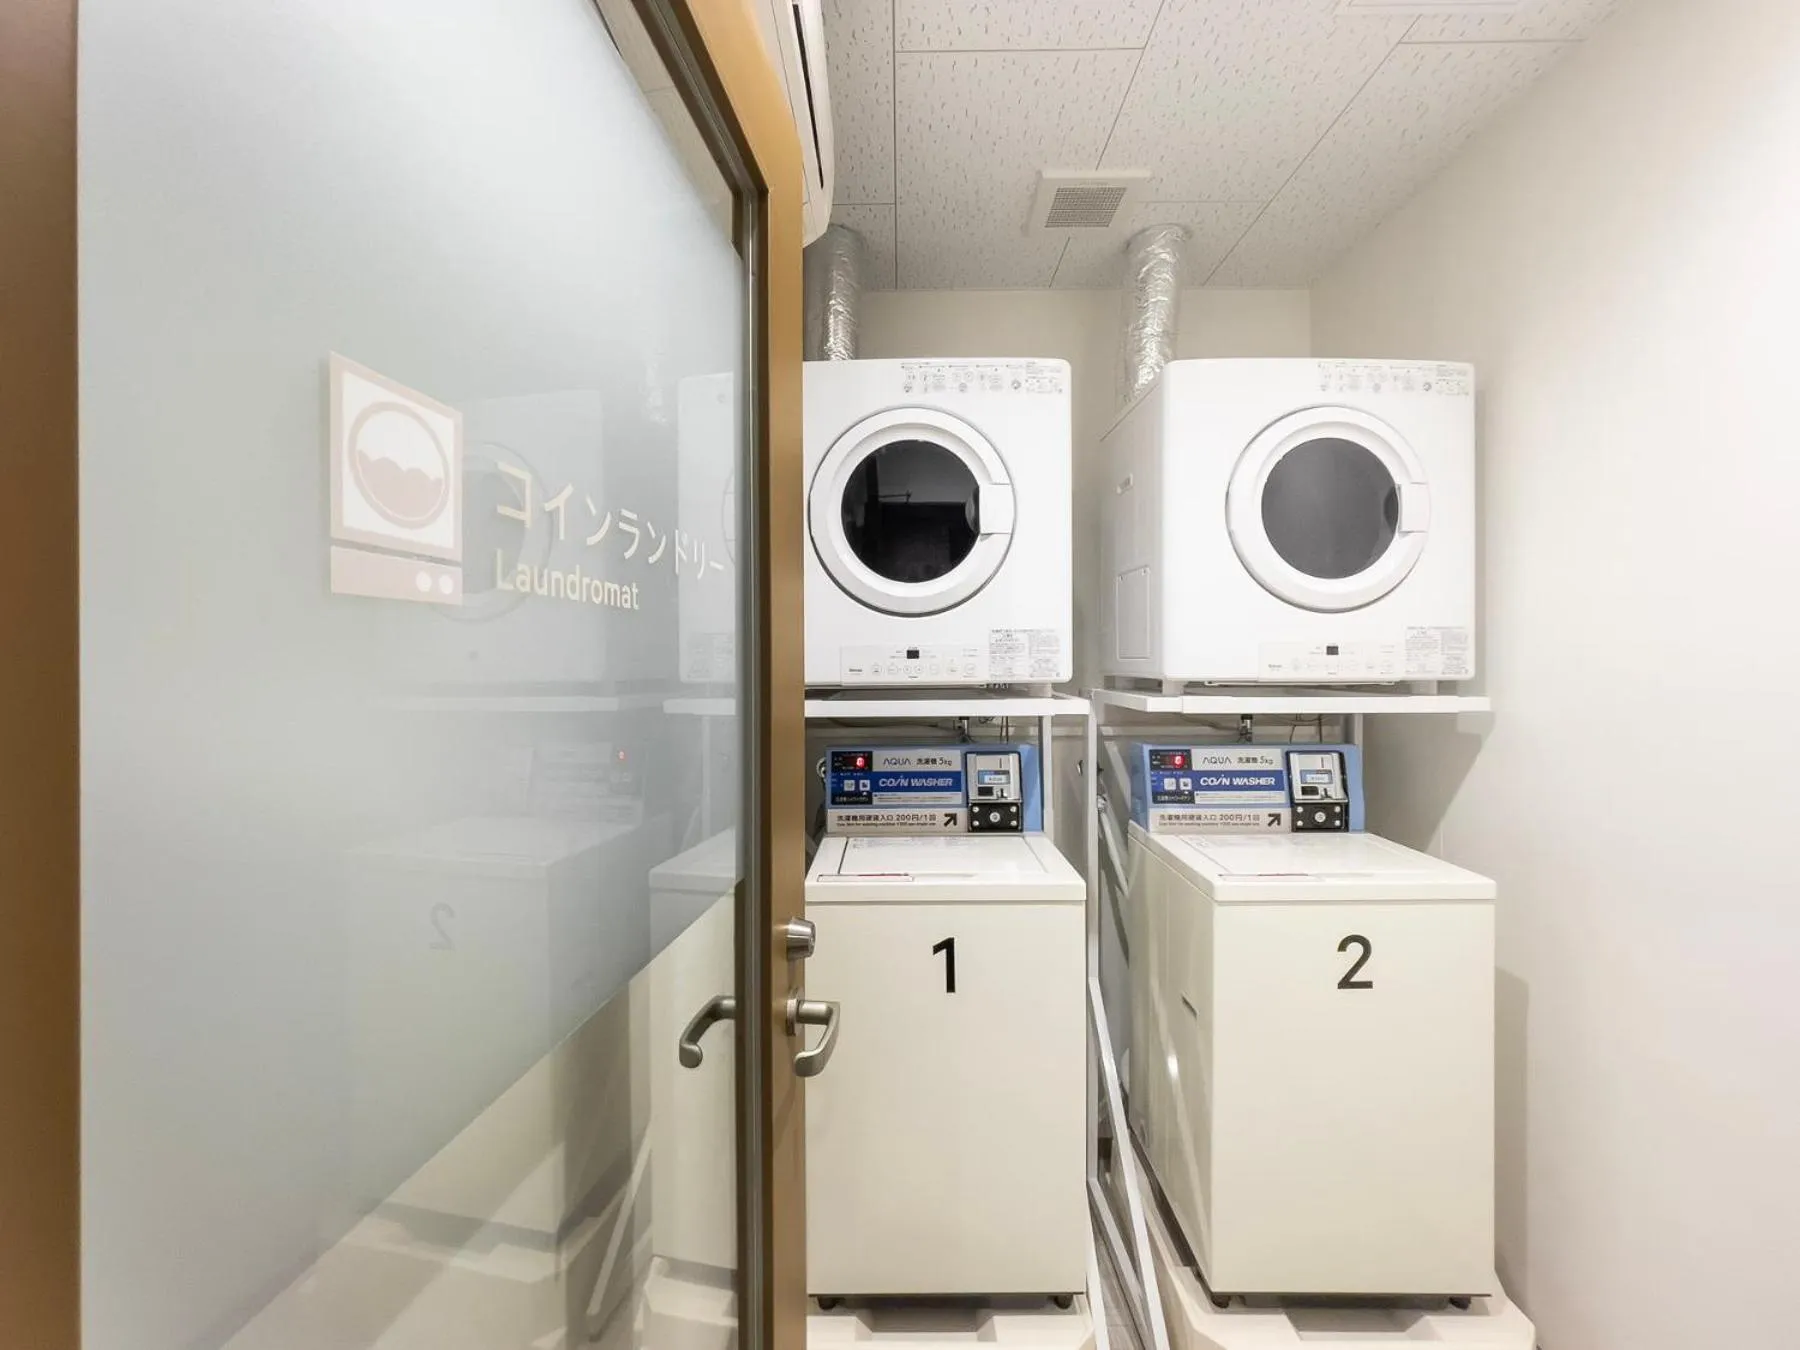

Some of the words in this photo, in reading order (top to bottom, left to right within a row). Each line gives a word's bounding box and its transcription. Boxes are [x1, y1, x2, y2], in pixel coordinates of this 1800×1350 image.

[497, 460, 725, 580] コインランドリー
[497, 548, 639, 610] Laundromat
[910, 778, 953, 787] WASHER
[1203, 756, 1232, 764] AQUA
[1232, 777, 1276, 786] WASHER
[932, 937, 956, 993] 1
[1337, 934, 1374, 990] 2
